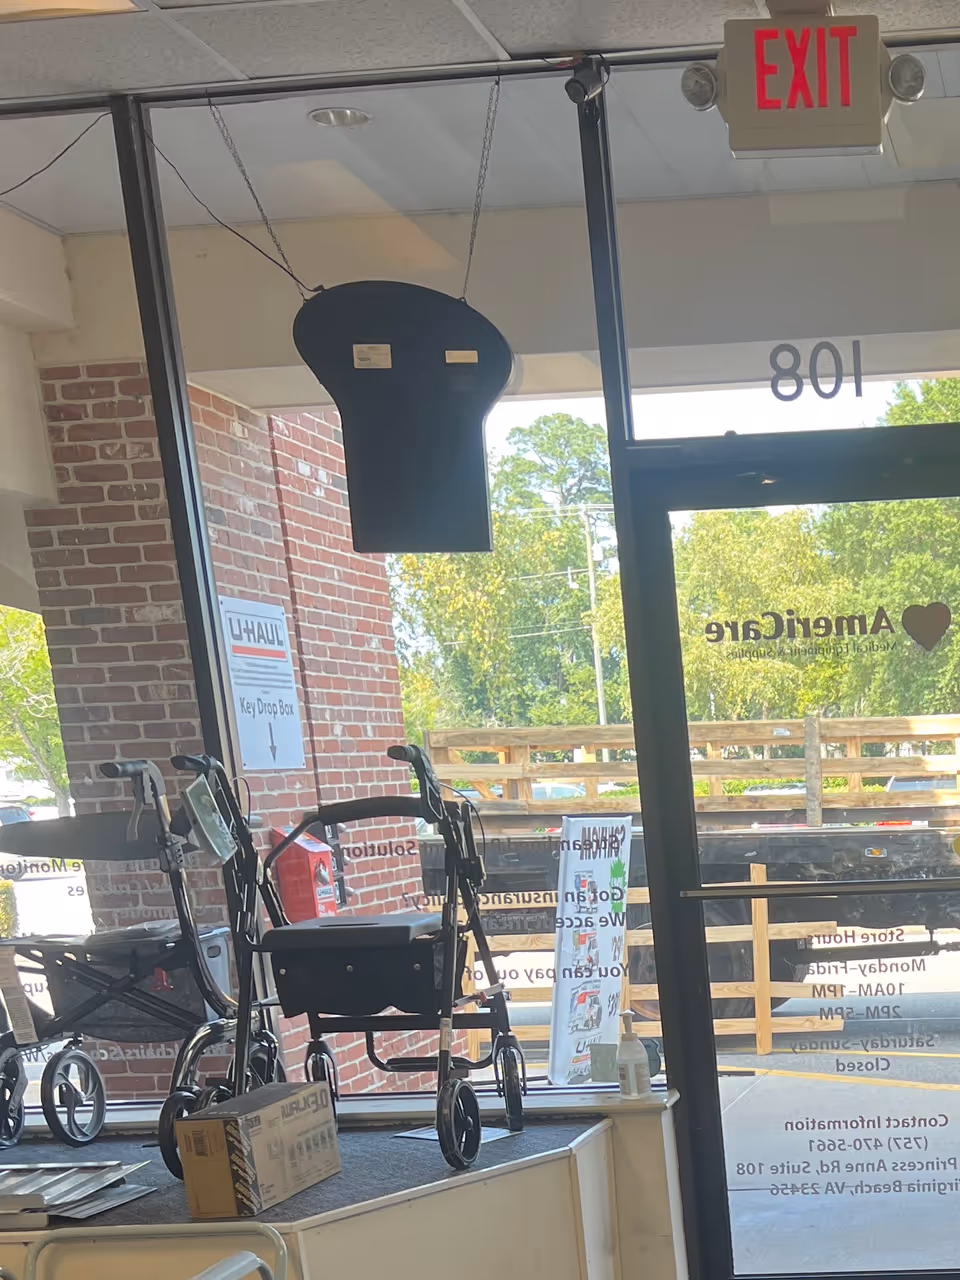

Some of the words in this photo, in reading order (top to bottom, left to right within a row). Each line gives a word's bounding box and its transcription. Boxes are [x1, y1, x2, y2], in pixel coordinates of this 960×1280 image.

[753, 25, 858, 110] EXIT
[228, 617, 284, 647] U-HAUL
[239, 697, 255, 719] Key
[257, 698, 278, 719] Drop
[279, 699, 294, 716] Box
